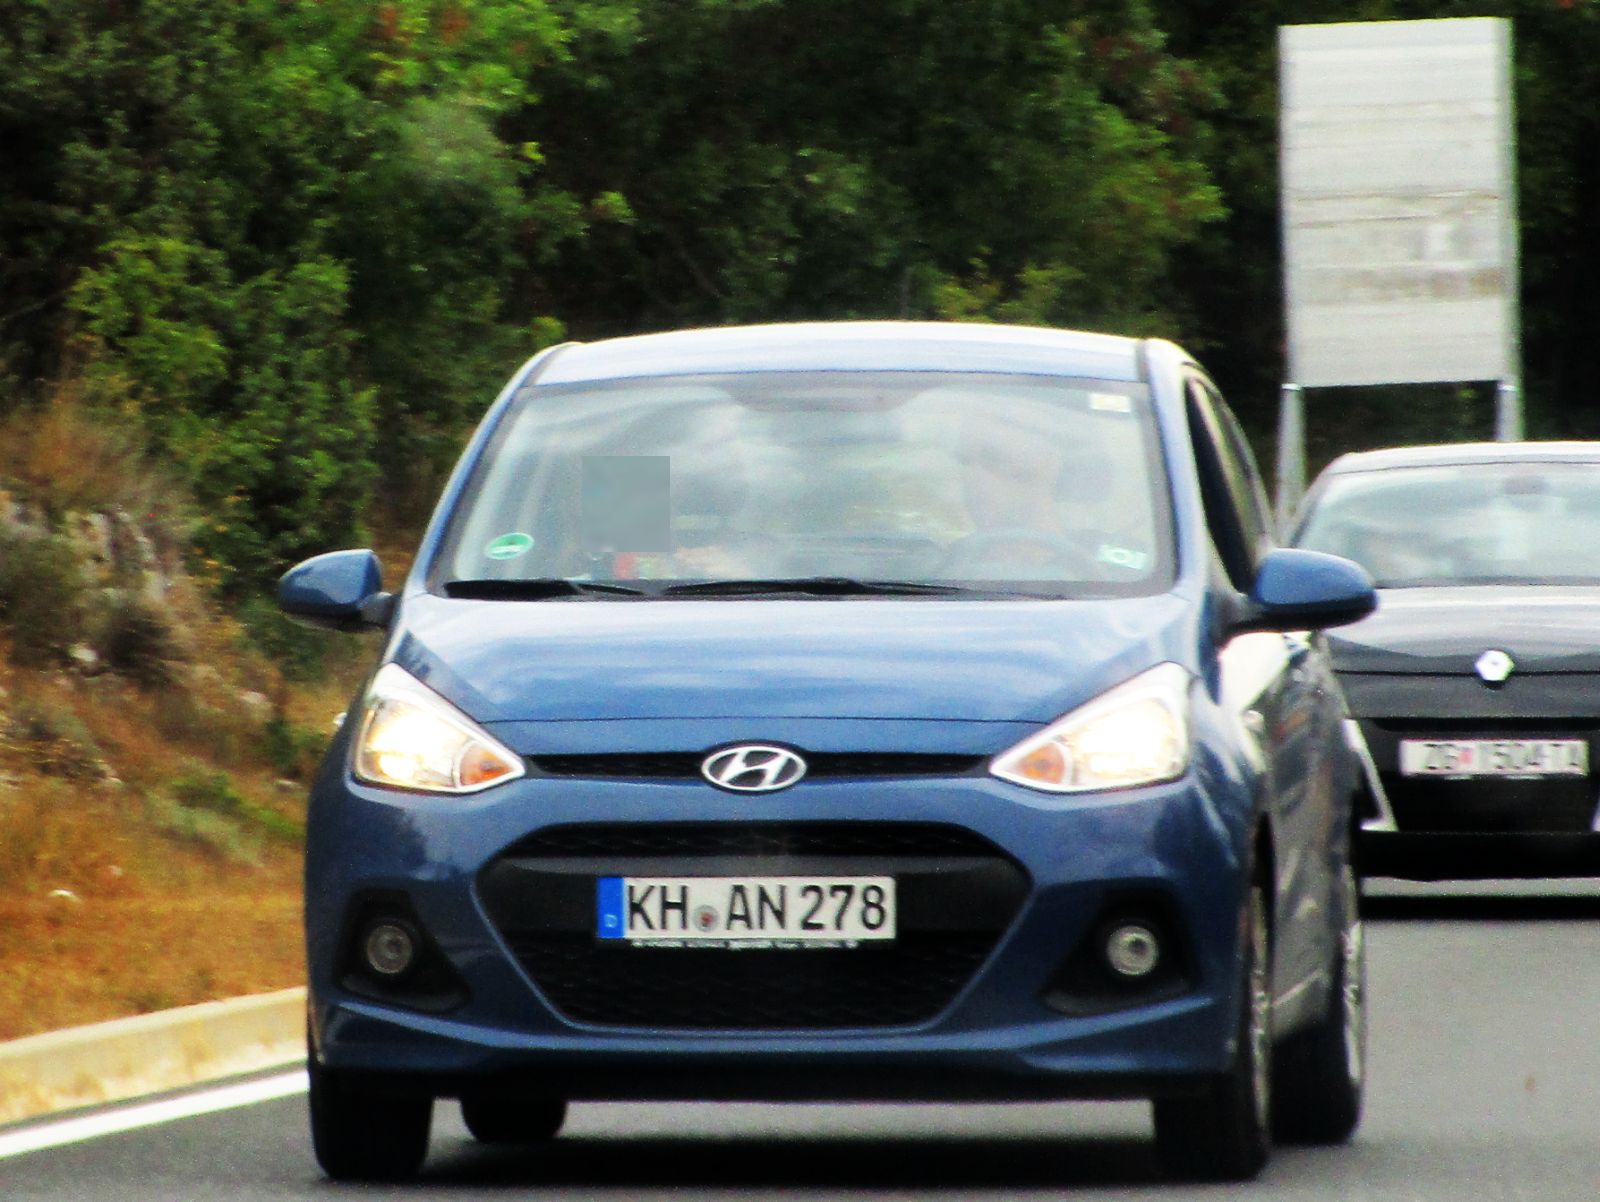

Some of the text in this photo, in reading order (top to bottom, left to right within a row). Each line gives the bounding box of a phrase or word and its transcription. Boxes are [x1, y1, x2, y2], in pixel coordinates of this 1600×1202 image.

[628, 884, 886, 931] KH AN 278
